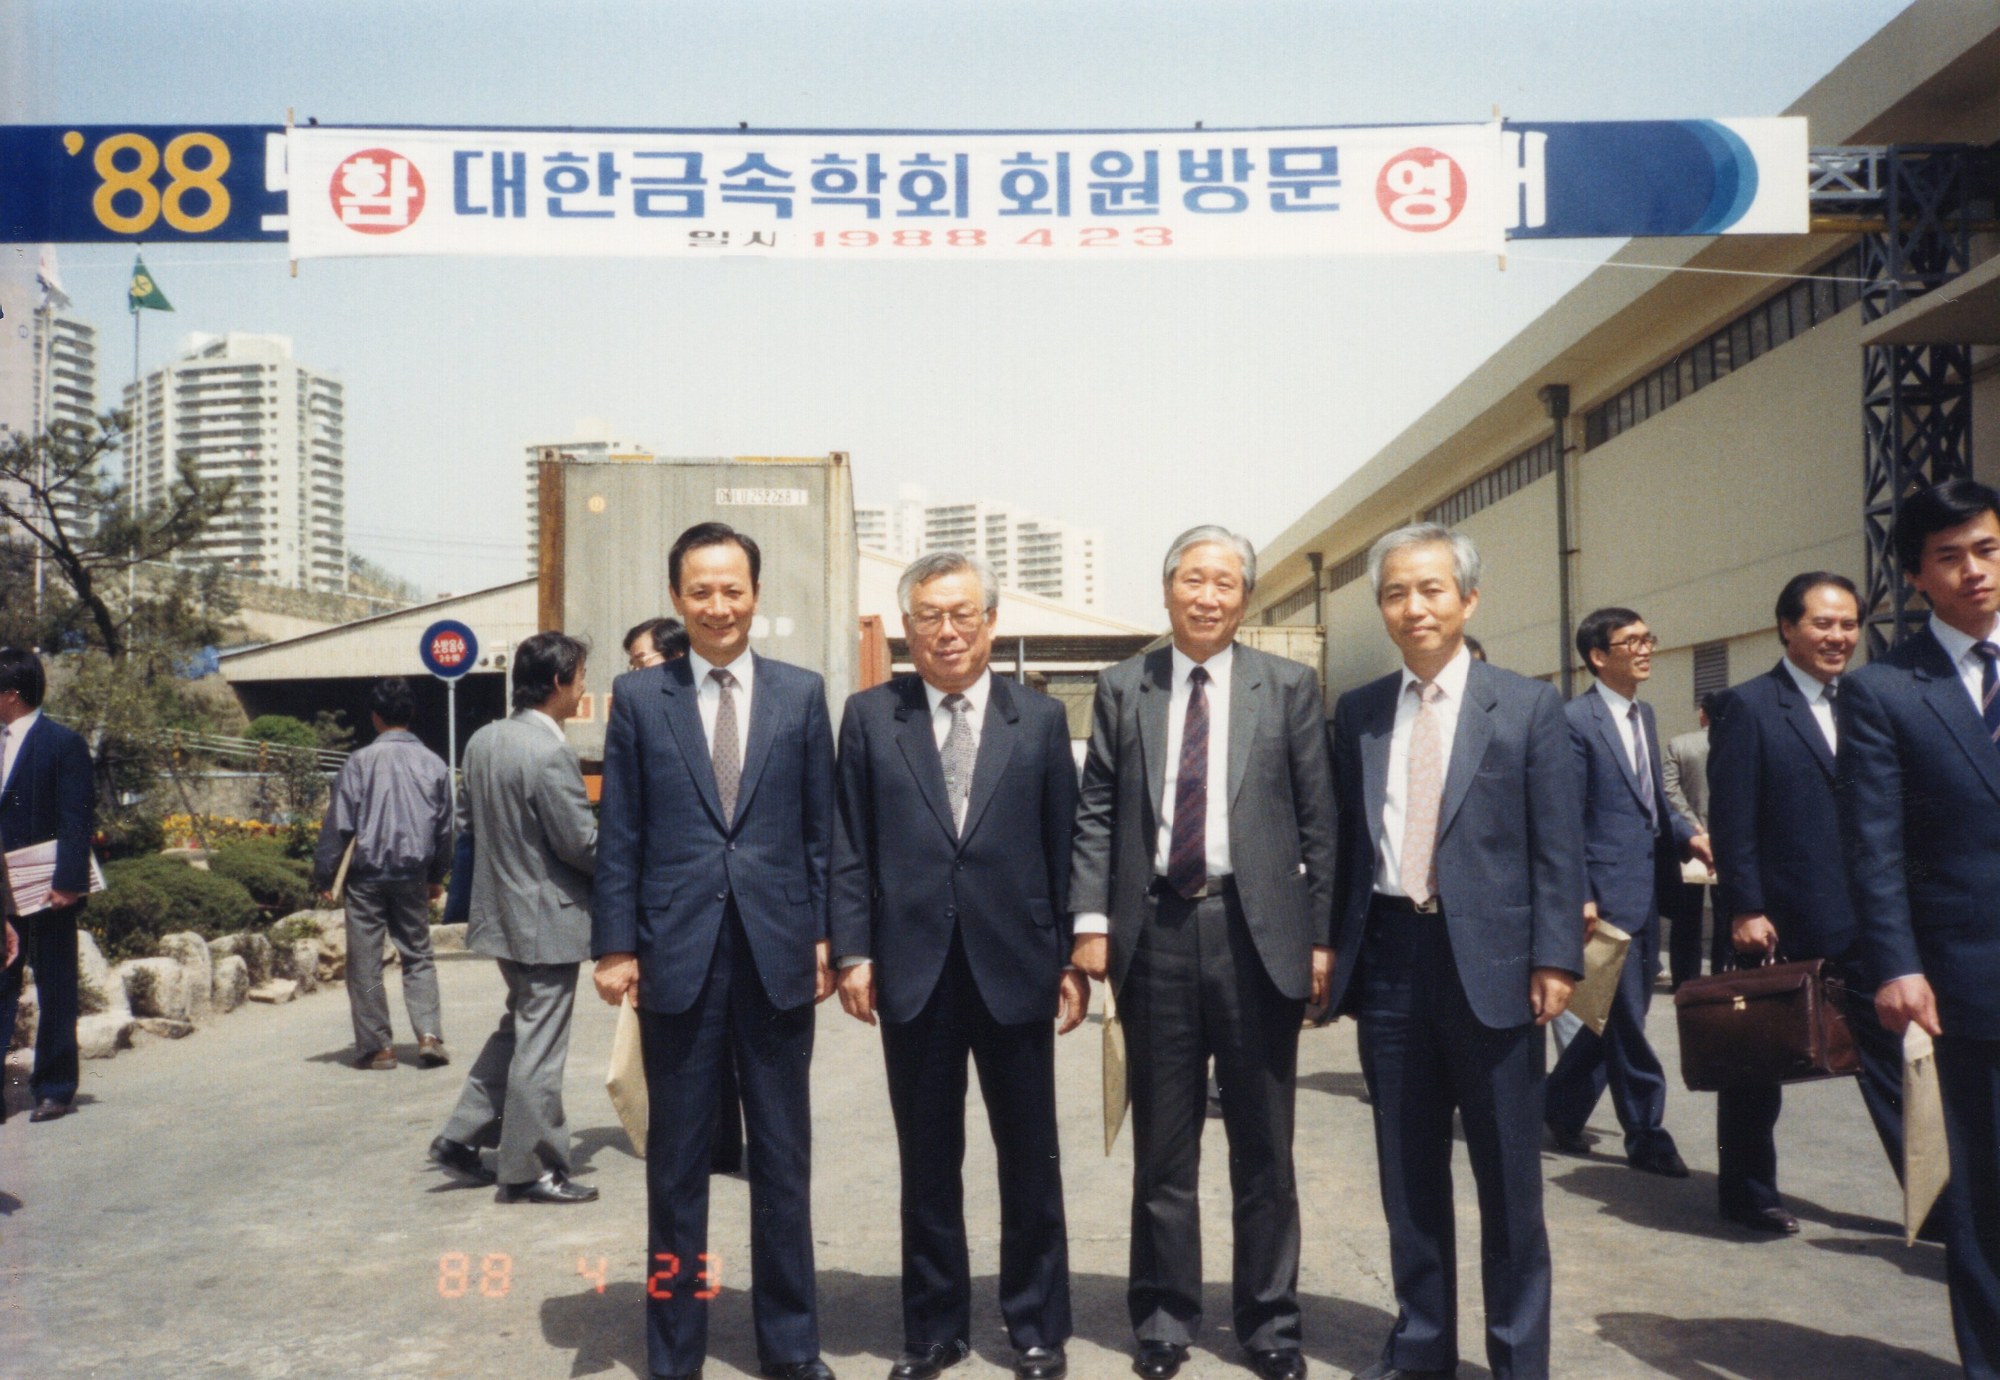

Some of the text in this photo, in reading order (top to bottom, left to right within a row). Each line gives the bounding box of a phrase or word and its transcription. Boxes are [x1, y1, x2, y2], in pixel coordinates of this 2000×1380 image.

[63, 131, 231, 233] '88
[337, 155, 419, 228] 환
[453, 151, 968, 219] 대한금속학회
[998, 147, 1342, 217] 회원방문
[1384, 154, 1455, 228] 영
[811, 228, 988, 249] 1988
[1015, 228, 1055, 249] 4
[1079, 225, 1174, 249] 23
